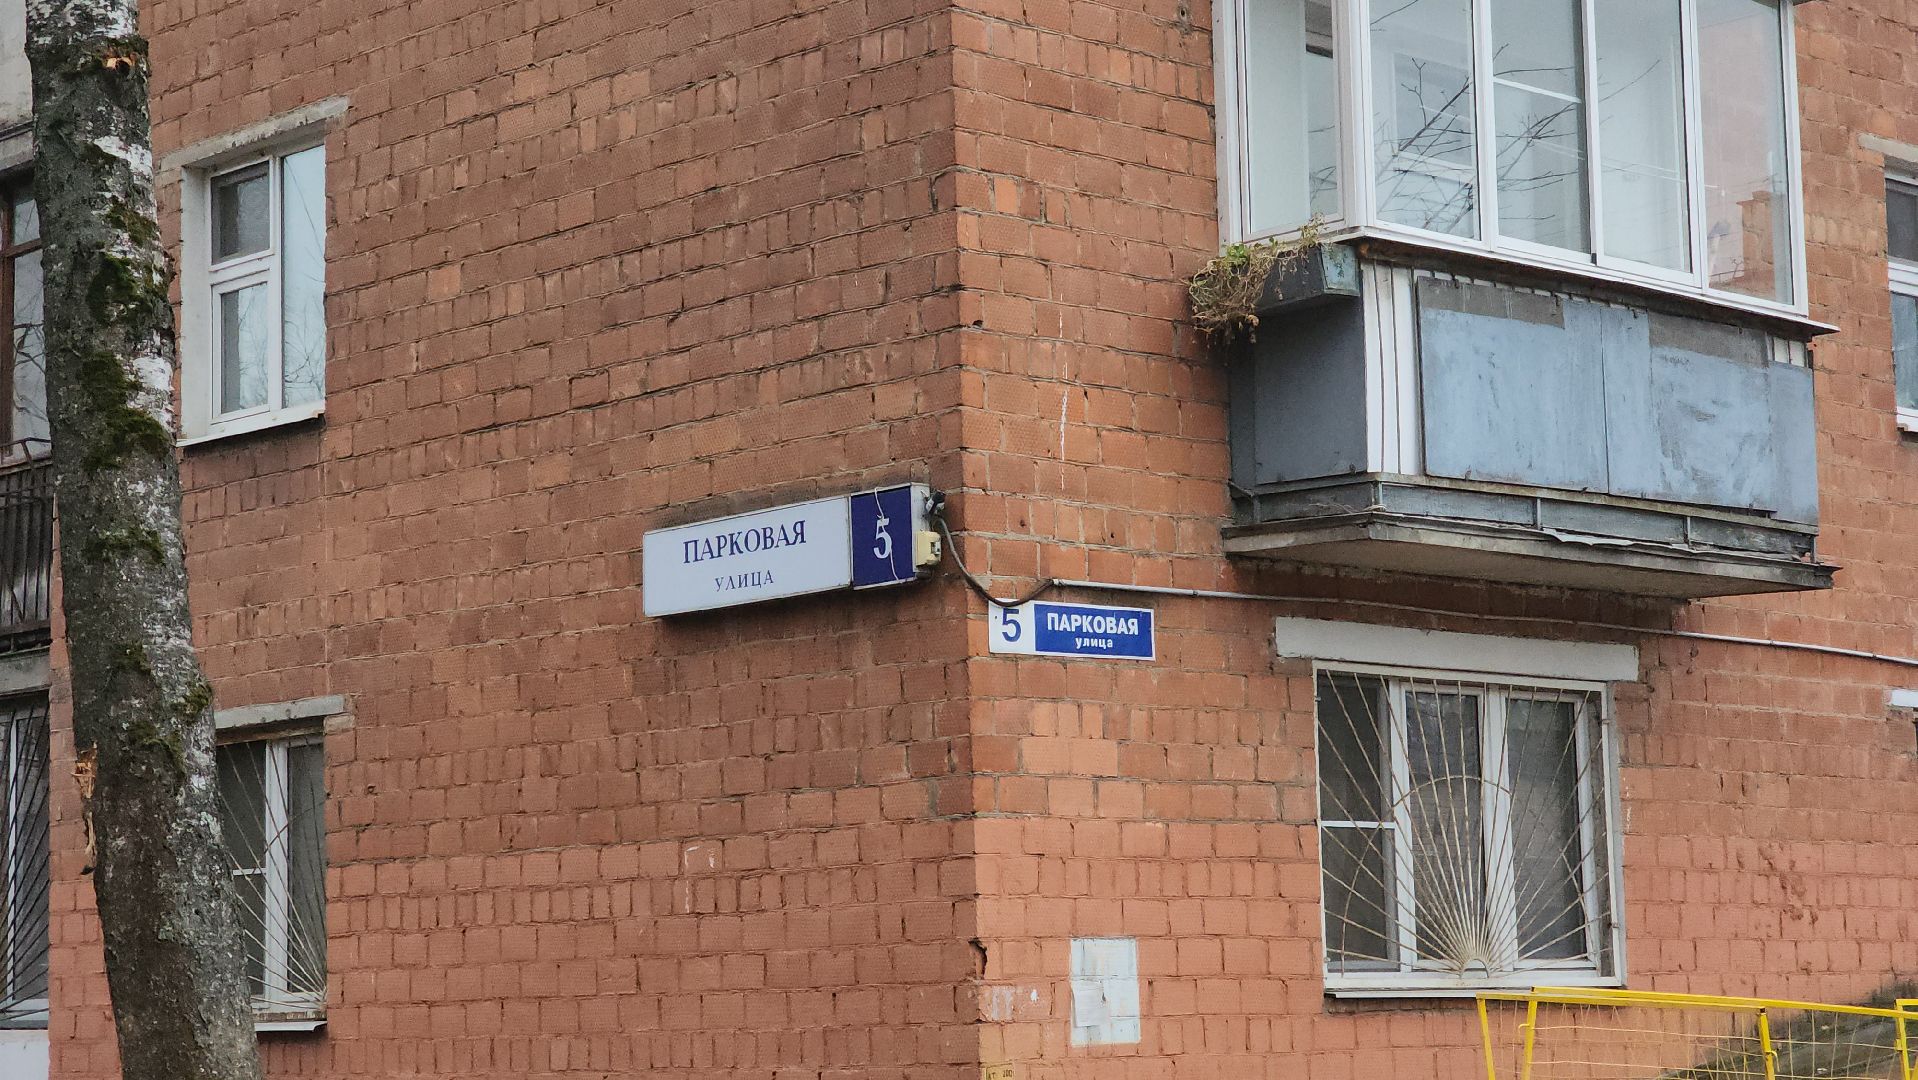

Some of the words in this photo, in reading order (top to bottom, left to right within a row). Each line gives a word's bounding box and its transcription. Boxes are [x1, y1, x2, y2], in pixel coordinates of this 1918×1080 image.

[683, 520, 806, 564] ПАРКОВАЯ
[873, 518, 892, 559] 5
[715, 570, 774, 592] УЛИЦА
[1002, 607, 1021, 642] 5
[1047, 613, 1138, 635] ПАРКОВАЯ
[1075, 636, 1113, 649] улица
